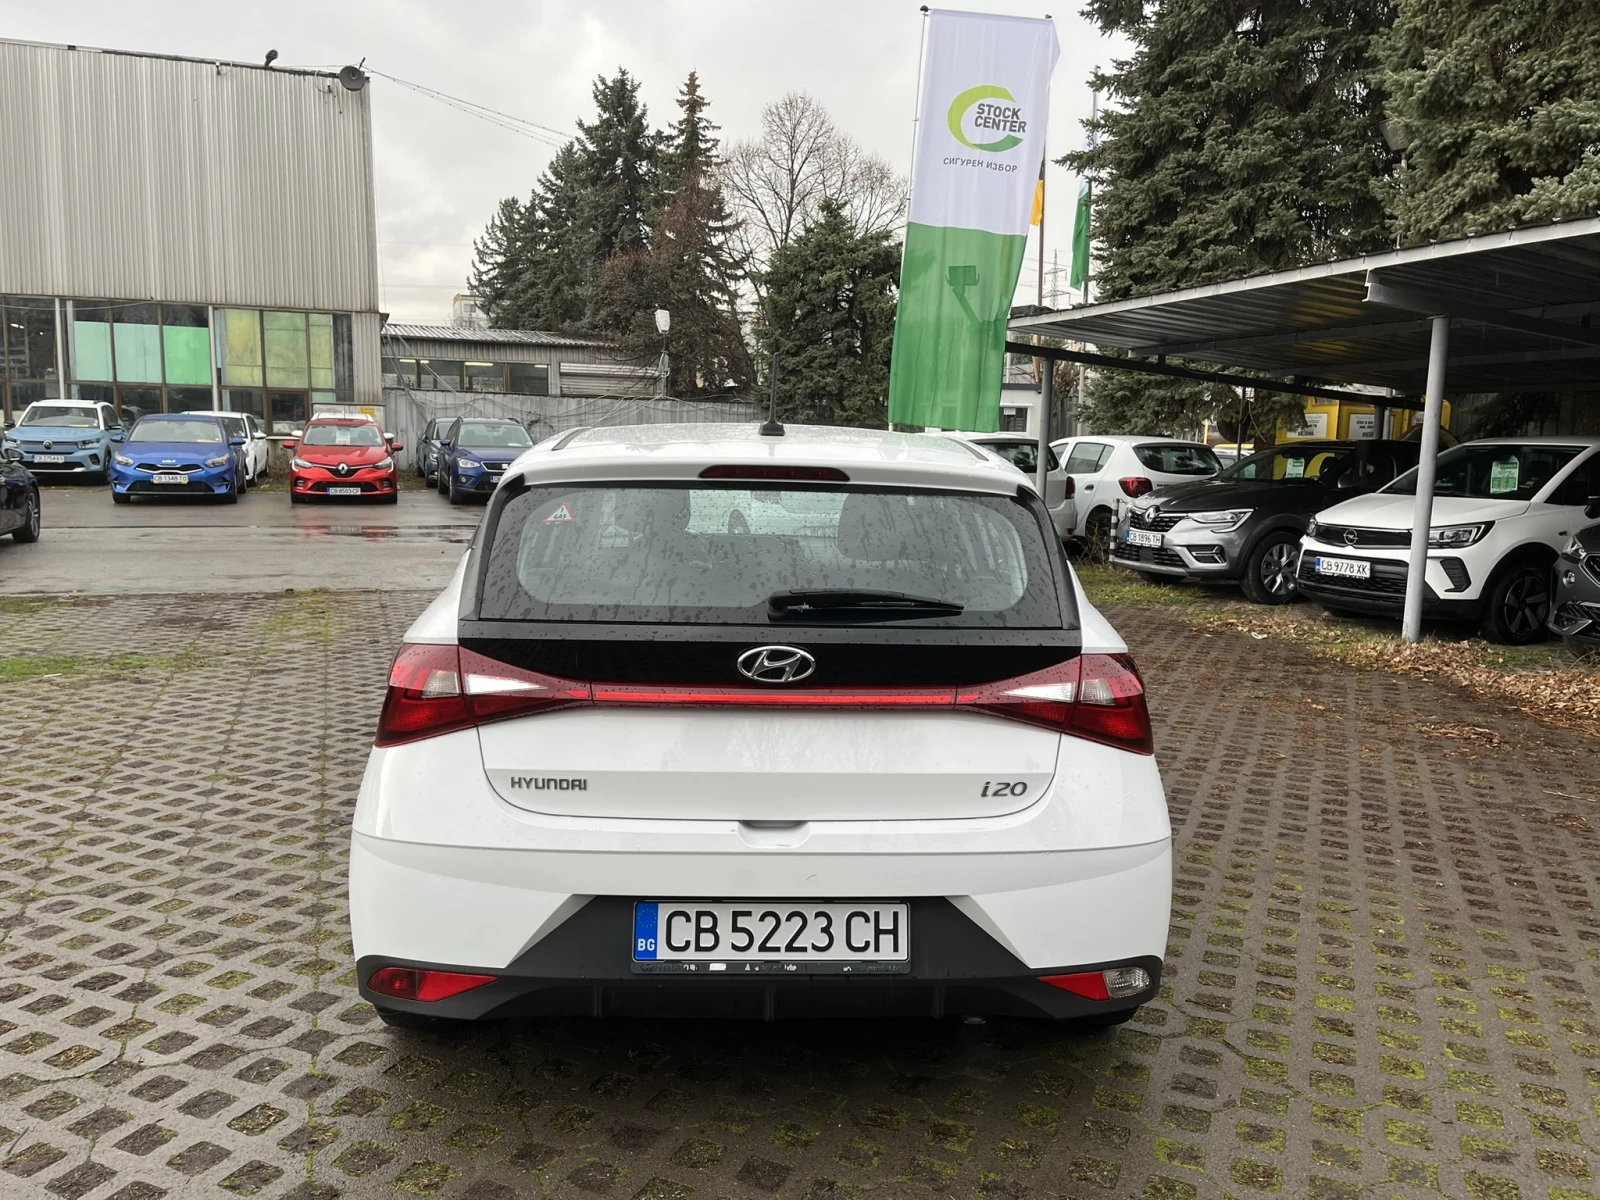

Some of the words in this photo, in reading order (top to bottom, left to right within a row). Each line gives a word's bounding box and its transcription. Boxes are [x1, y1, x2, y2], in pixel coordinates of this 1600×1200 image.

[976, 103, 1022, 120] STOCK
[974, 116, 1027, 133] CENTER
[943, 157, 984, 168] СИГУРЕН
[986, 161, 1018, 173] ИЗБОР
[1130, 532, 1137, 541] CB
[1138, 533, 1151, 543] 1896
[1152, 535, 1161, 544] TH
[1321, 560, 1332, 571] CB
[1334, 561, 1355, 574] 9778
[1356, 564, 1367, 575] XK
[510, 776, 587, 791] HYUNDAI
[981, 781, 1028, 798] i20
[665, 910, 721, 953] CB
[730, 910, 835, 954] 5223
[844, 910, 900, 953] CH
[637, 938, 656, 952] BG
